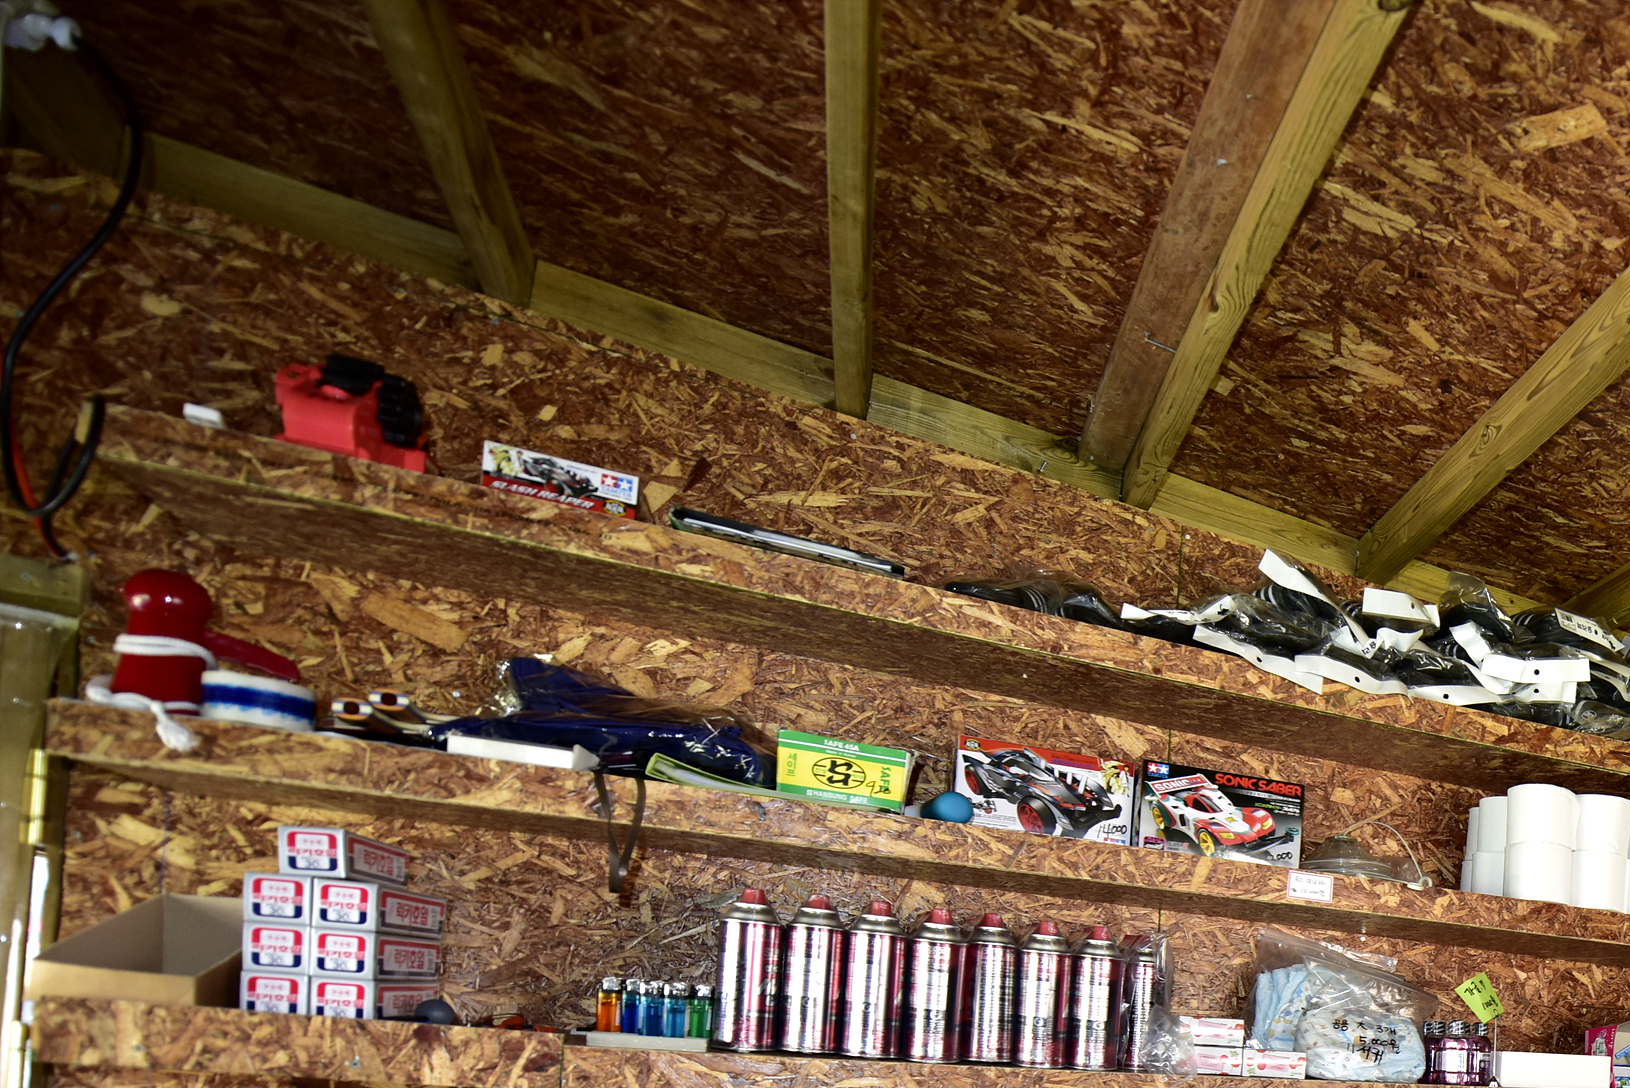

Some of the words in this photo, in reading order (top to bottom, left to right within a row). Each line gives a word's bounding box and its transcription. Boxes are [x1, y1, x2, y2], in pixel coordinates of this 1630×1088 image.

[489, 480, 537, 495] SLASH
[538, 488, 596, 510] REAPER
[823, 739, 844, 749] SAFE
[1155, 779, 1190, 793] SONIC
[1214, 773, 1256, 790] SONIC
[1258, 781, 1302, 797] SABER
[811, 790, 847, 800] HANSUNG
[850, 795, 868, 804] SAFE
